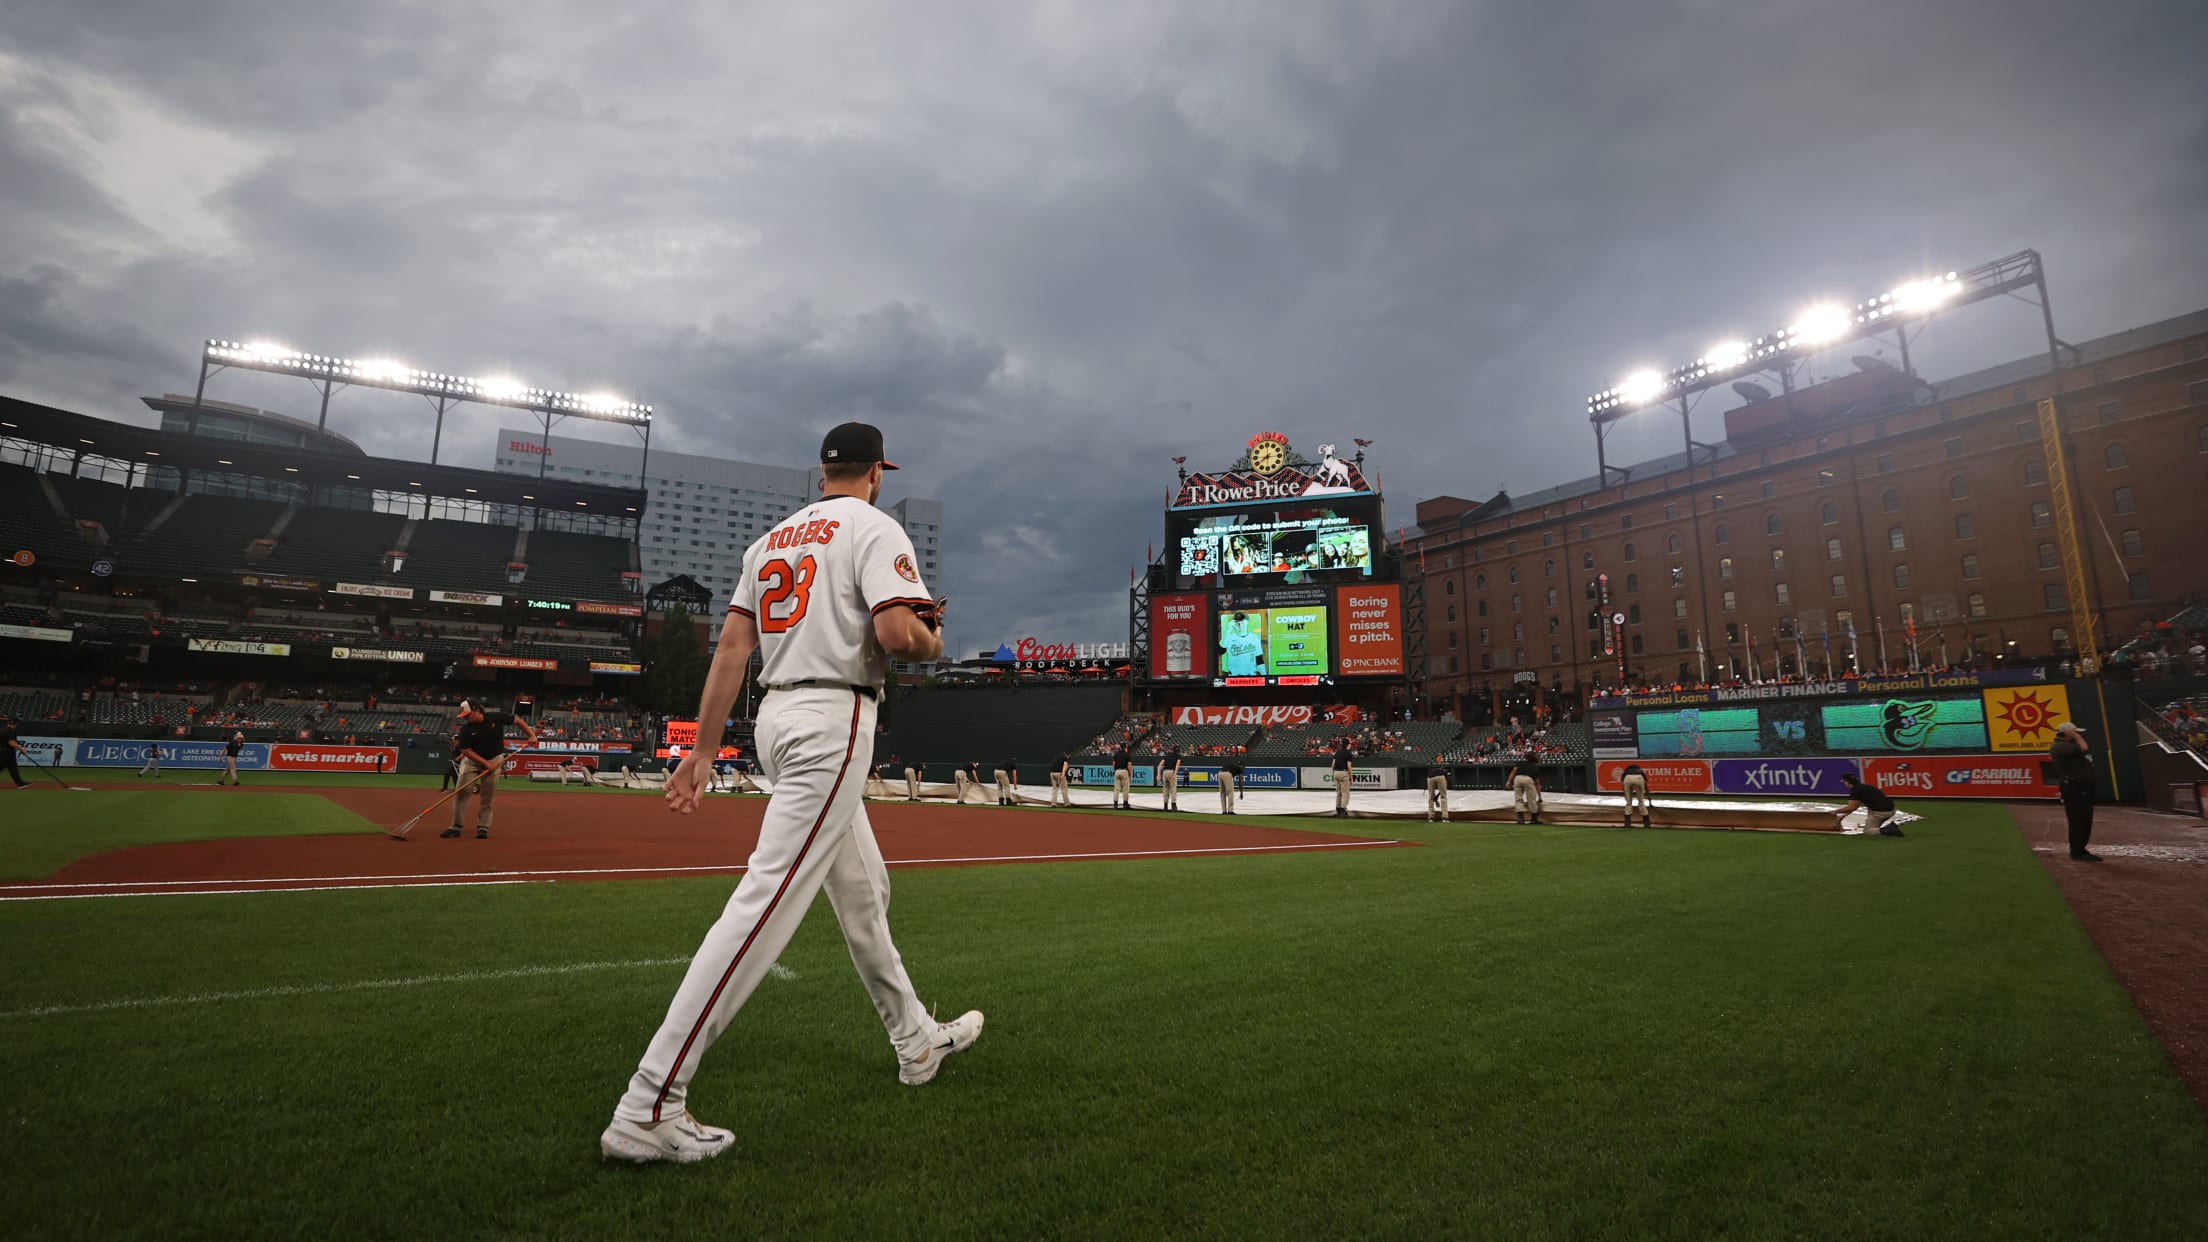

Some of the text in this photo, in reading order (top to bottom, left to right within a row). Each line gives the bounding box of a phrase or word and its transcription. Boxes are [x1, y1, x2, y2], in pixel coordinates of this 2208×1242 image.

[510, 441, 552, 456] Hilton
[1241, 523, 1261, 531] code
[1262, 522, 1271, 530] to
[1272, 520, 1301, 529] submit
[1302, 519, 1321, 527] your
[766, 519, 840, 552] ROGERS
[22, 554, 28, 562] 8
[96, 564, 109, 572] 42
[527, 600, 560, 609] 7:40:19
[1349, 596, 1388, 608] Boring
[1276, 615, 1317, 623] COWBOY
[1352, 609, 1386, 618] never
[1350, 620, 1390, 630] misses
[1360, 631, 1394, 644] pitch.
[1016, 637, 1130, 661] Coors LIGH
[388, 650, 424, 661] UNION
[1014, 661, 1056, 669] ROOF
[1374, 658, 1400, 666] BANK
[1857, 674, 1979, 692] Personal Loans
[1626, 682, 1848, 706] Personal Loans MARINER FINANCE
[2022, 709, 2034, 721] L
[668, 728, 697, 737] TONIG
[1773, 720, 1806, 740] VS
[570, 742, 599, 751] BATH
[280, 751, 318, 763] weis
[1249, 772, 1282, 783] Health
[1641, 767, 1703, 777] TUMN LAKE
[1744, 763, 1823, 790] xfinity
[1971, 767, 2032, 779] CARROLL
[1876, 771, 1934, 790] HIGH'S
